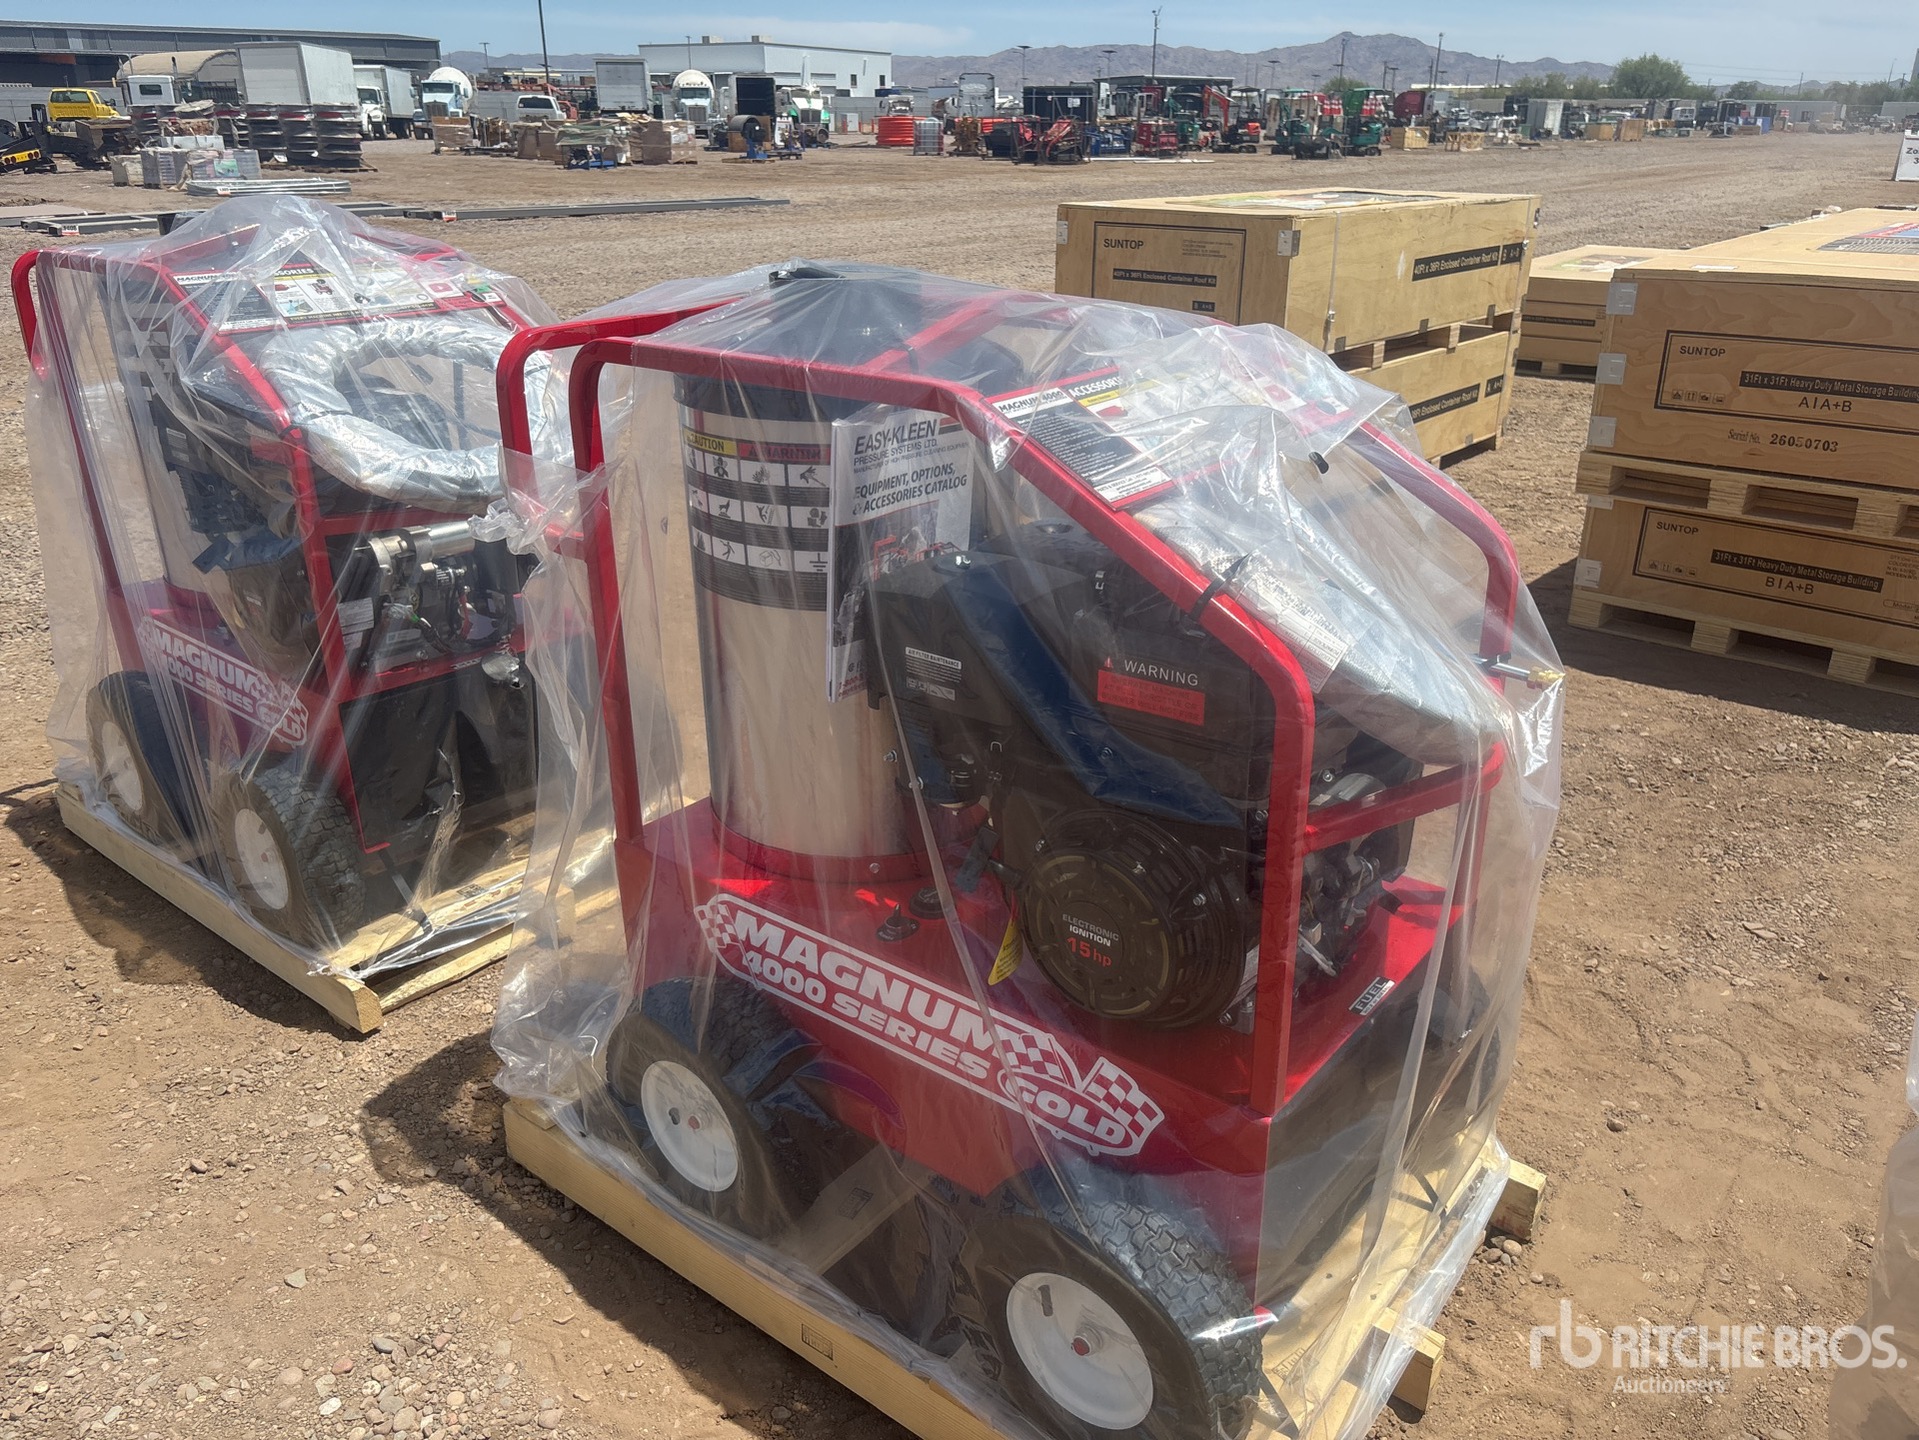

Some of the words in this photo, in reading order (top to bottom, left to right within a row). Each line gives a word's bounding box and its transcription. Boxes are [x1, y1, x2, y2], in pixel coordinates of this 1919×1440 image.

[1906, 147, 1919, 155] Zo
[1103, 239, 1144, 250] SUNTOP
[1440, 257, 1460, 271] Enclosed
[1460, 255, 1481, 267] Container
[1481, 253, 1492, 264] Roof
[1143, 272, 1167, 281] Enclosed
[1167, 274, 1193, 283] Container
[1193, 275, 1208, 284] Roof
[1679, 345, 1726, 357] SUNTOP
[1069, 376, 1122, 398] ACCESSORI
[1744, 373, 1762, 384] 31Ft
[1763, 376, 1769, 385] x
[1769, 375, 1788, 387] 31Ft
[1789, 377, 1814, 392] Heavy
[1814, 379, 1833, 393] Duty
[1834, 381, 1854, 392] Metal
[1855, 383, 1887, 397] Storage
[999, 396, 1040, 413] MAGNUM
[1421, 403, 1440, 416] Enclosed
[1440, 396, 1461, 411] Container
[690, 433, 725, 453] CAUTION
[854, 419, 938, 456] EASY-KLEEN
[1728, 428, 1749, 443] Serial
[853, 450, 889, 466] PRESSURE
[890, 442, 922, 457] SYSTEMS
[854, 472, 909, 499] EQUIPMENT,
[910, 462, 956, 483] OPTIONS,
[852, 502, 862, 515] &
[863, 486, 923, 514] ACCESSORIES
[924, 474, 967, 495] CATALOG
[1656, 521, 1699, 536] SUNTOP
[1715, 551, 1733, 563] 31Ft
[1739, 556, 1756, 568] 31Ft
[1757, 558, 1779, 573] Heavy
[1779, 562, 1796, 576] Duty
[1797, 565, 1817, 577] Metal
[1818, 568, 1847, 584] Storage
[1847, 574, 1879, 590] Building
[153, 627, 257, 693] MAGNUM
[1124, 659, 1198, 686] WARNING
[195, 671, 254, 713] SERIES
[1062, 913, 1119, 942] ELECTRONIC
[1069, 924, 1111, 947] IGNITION
[734, 910, 1023, 1062] MAGNUM
[1355, 981, 1387, 1010] FUEL
[742, 950, 827, 1004] 4000
[831, 993, 991, 1079] SERIES
[1005, 1075, 1126, 1145] GOLD
